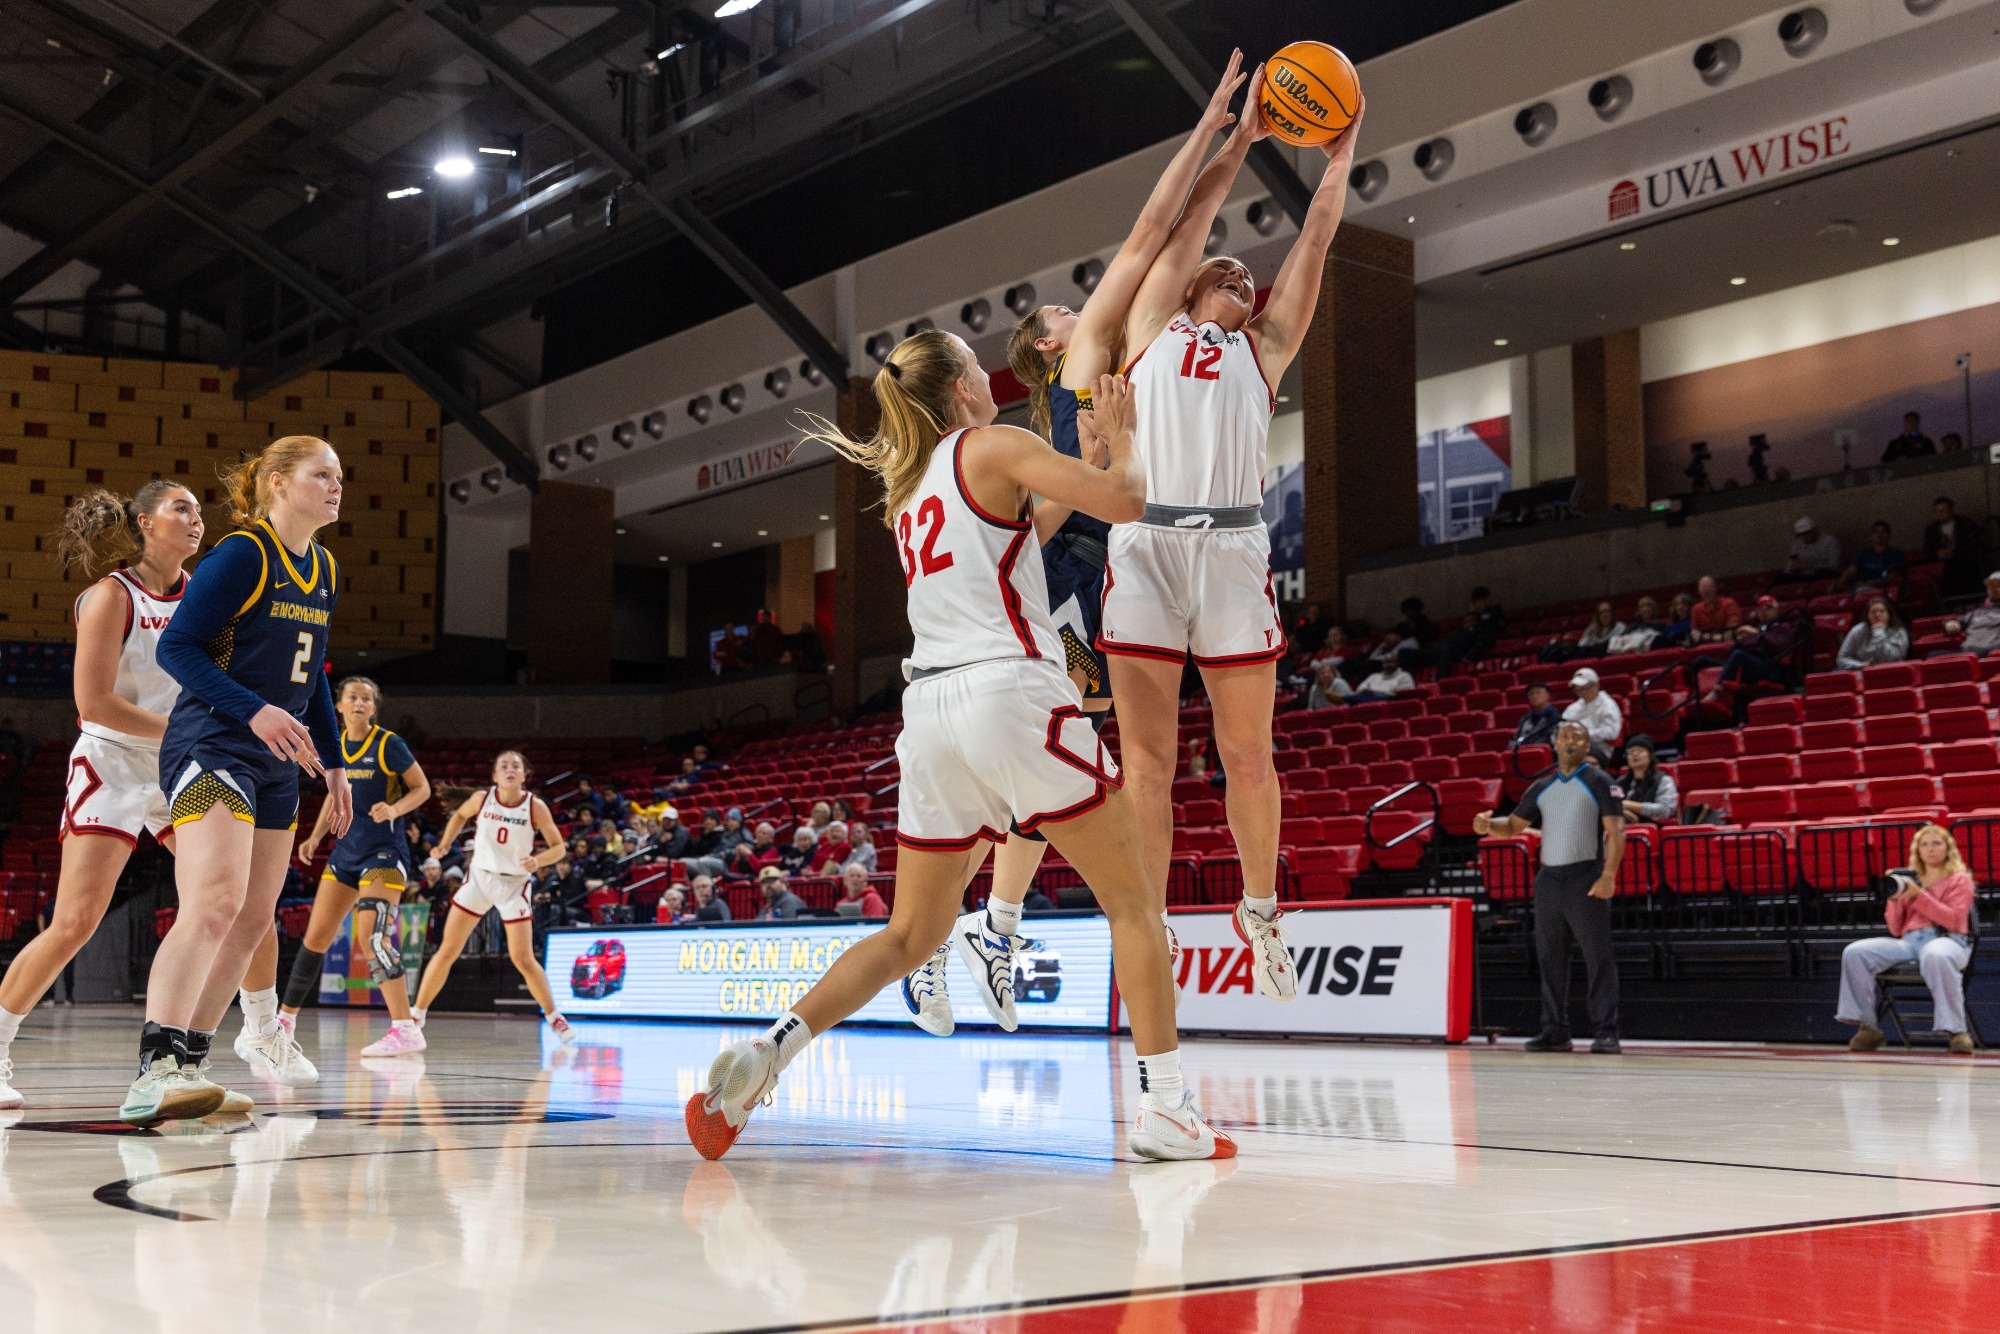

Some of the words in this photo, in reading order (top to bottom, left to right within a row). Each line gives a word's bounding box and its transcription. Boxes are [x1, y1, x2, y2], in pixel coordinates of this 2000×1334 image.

[1274, 65, 1329, 121] Wilson
[1263, 100, 1306, 138] NCAA
[1645, 155, 1728, 208] UVA
[1730, 116, 1851, 183] WISE
[1180, 338, 1223, 380] 12
[712, 456, 746, 486] UVA
[747, 440, 795, 475] WISE
[899, 494, 954, 589] 32
[290, 631, 313, 684] 2
[497, 827, 508, 844] 0
[678, 938, 781, 973] MORGAN
